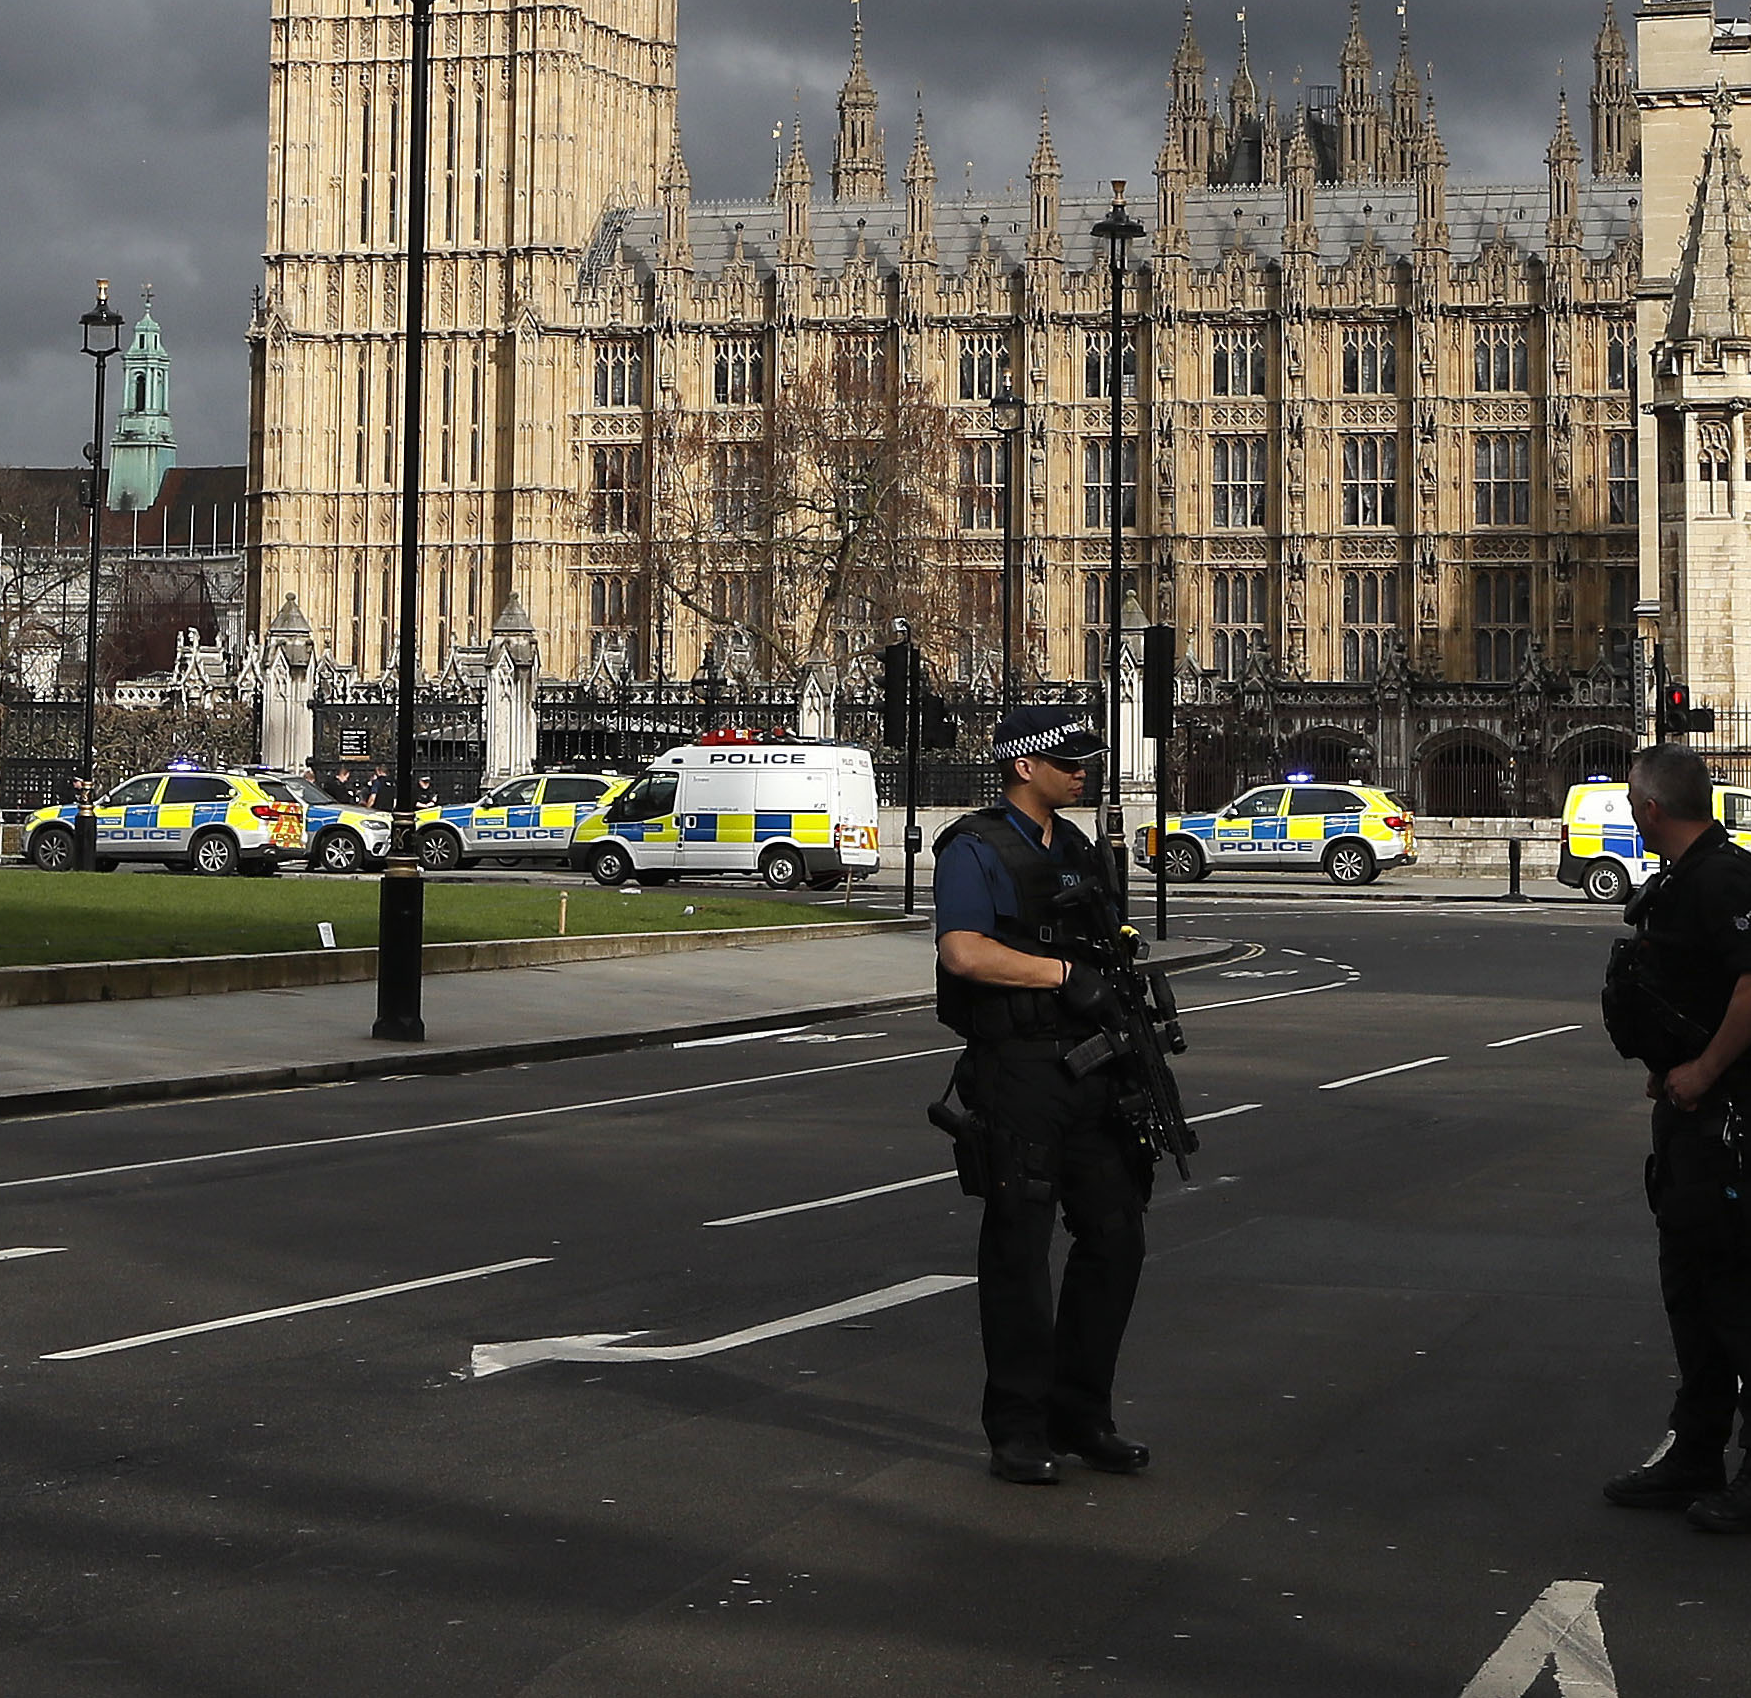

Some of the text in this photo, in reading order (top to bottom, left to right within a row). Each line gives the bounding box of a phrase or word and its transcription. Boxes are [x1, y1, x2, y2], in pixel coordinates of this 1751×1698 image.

[710, 754, 806, 764] POLICE
[477, 829, 564, 840] POLICE
[1220, 842, 1313, 852] POLICE
